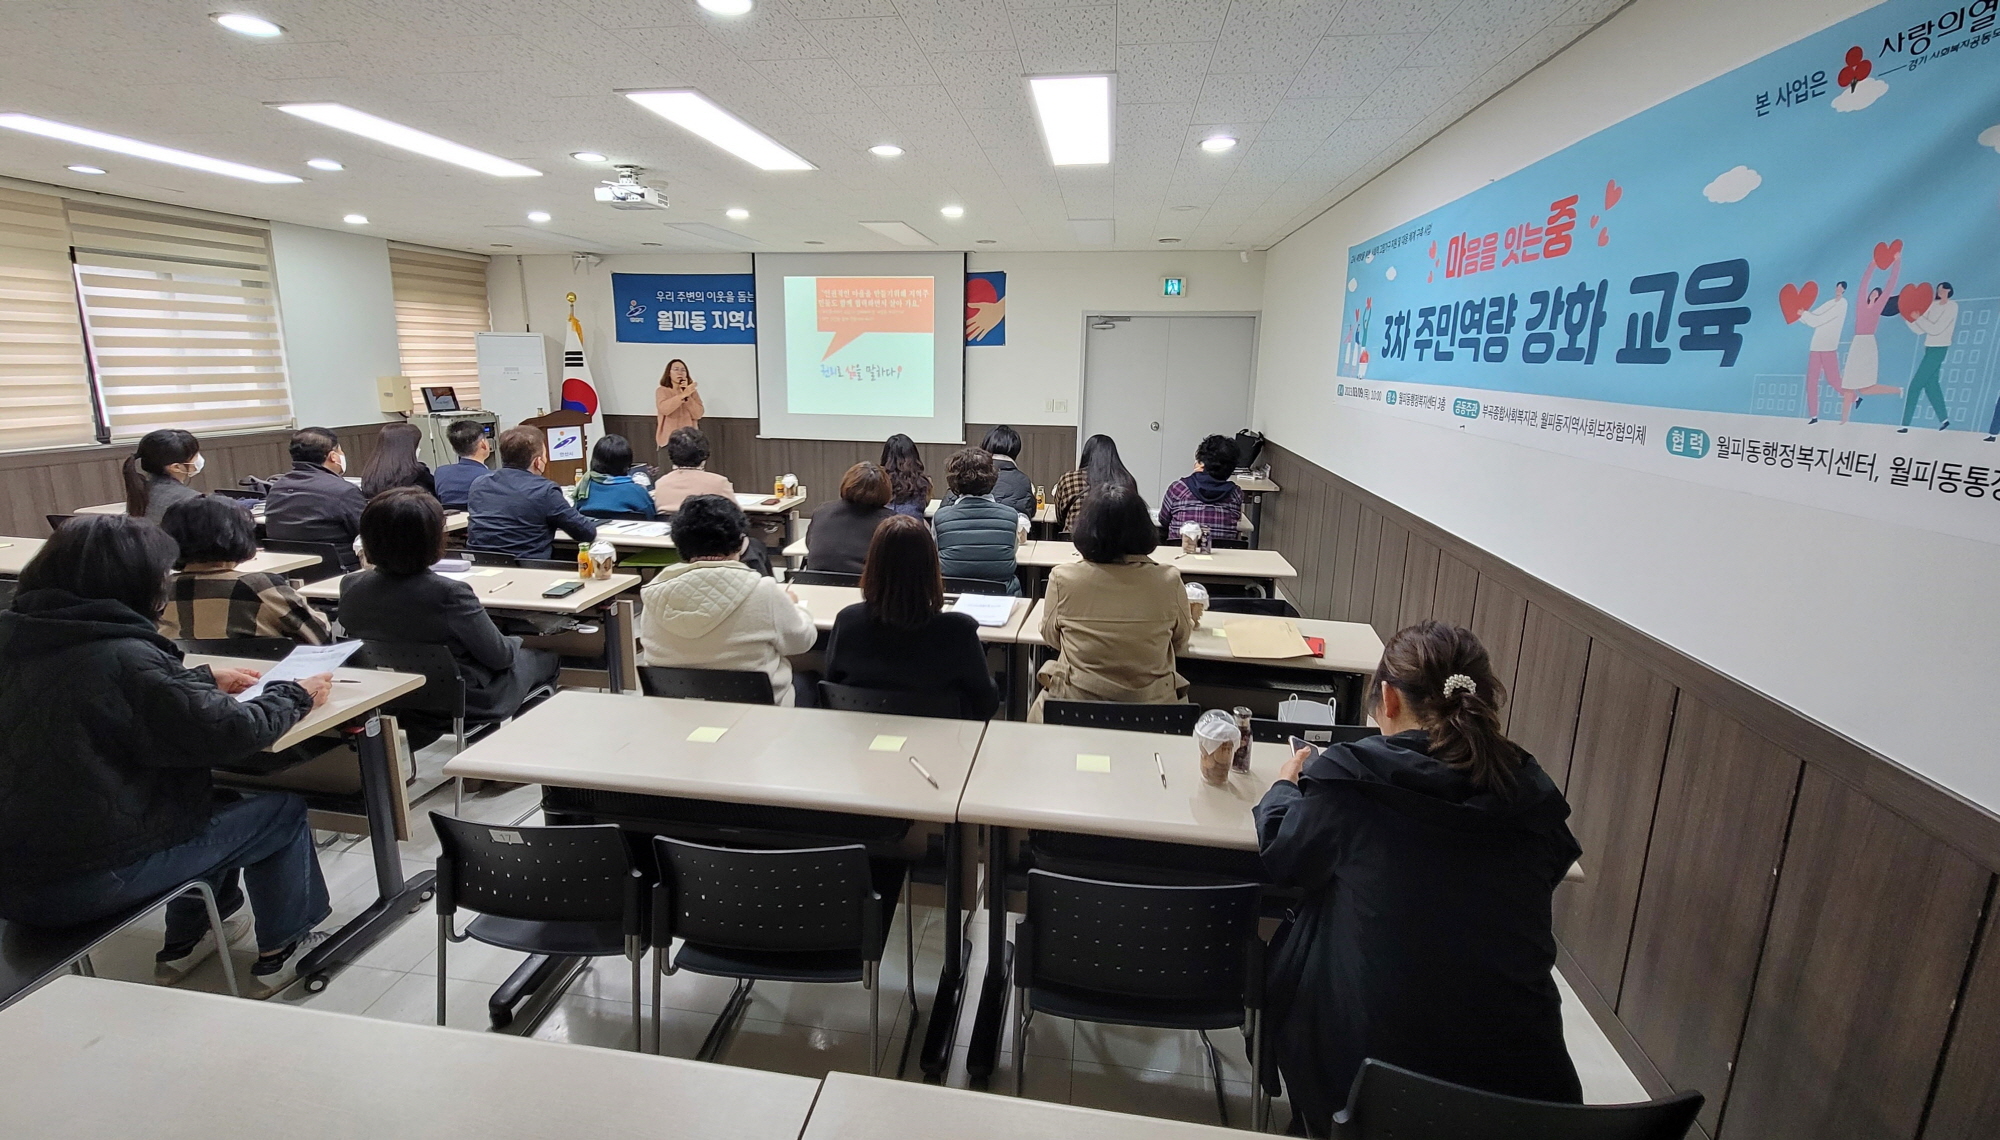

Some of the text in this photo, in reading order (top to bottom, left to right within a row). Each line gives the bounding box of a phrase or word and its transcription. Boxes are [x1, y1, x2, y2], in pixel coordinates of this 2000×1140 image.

[1908, 55, 1928, 72] 경기
[1755, 70, 1828, 117] 본 사업은
[1445, 194, 1579, 279] 마음을 잇는중
[656, 291, 754, 303] 우리 주변의 이웃을 돕는
[1381, 258, 1752, 368] 3차 주민역량 강화 교육
[657, 310, 706, 332] 월피동
[1454, 400, 1478, 417] 공동주관
[1482, 404, 1647, 446] 부곡종합사회복지관, 월피동지역사회보장협의체
[1716, 435, 1880, 483] 월피동행정복지센터,
